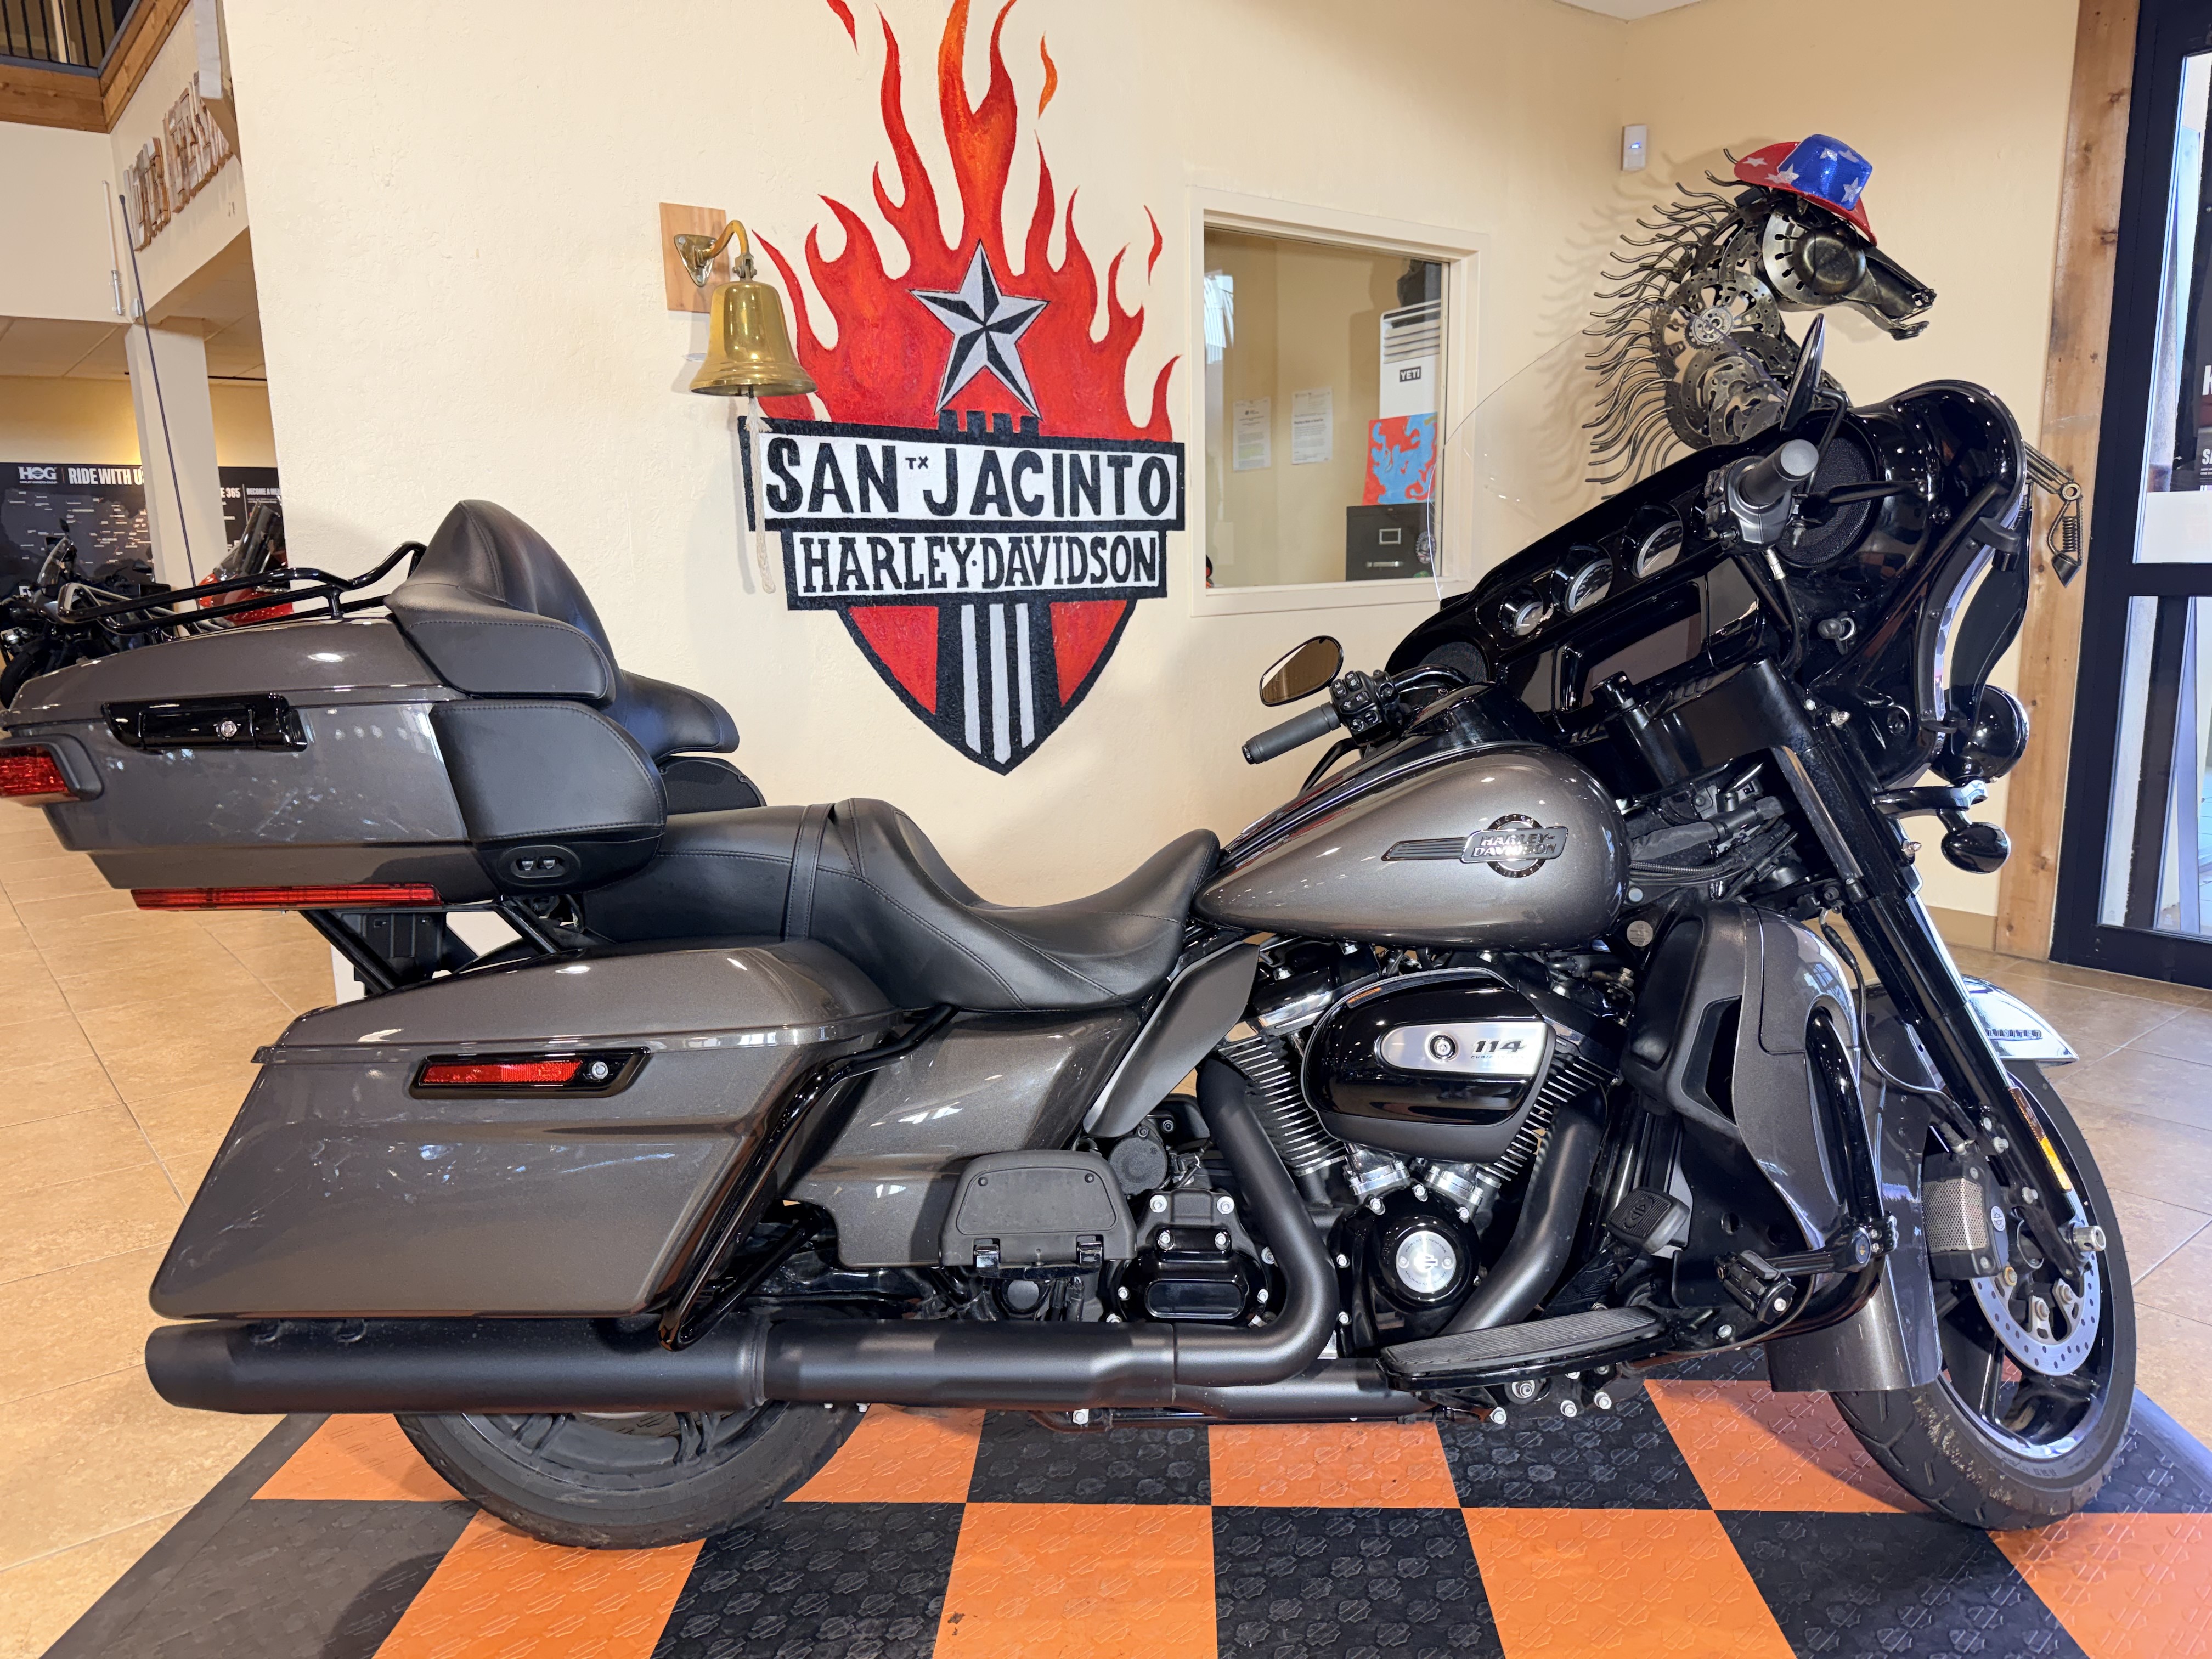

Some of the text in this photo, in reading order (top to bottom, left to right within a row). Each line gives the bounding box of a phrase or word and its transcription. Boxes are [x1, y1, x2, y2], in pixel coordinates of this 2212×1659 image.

[1400, 369, 1420, 380] YETI
[905, 456, 929, 470] TX
[18, 467, 57, 480] HOG
[68, 467, 144, 485] RIDE WITH U
[766, 437, 899, 513] SAN
[923, 448, 1171, 517] JACINTO
[225, 487, 241, 498] 365
[1471, 843, 1557, 857] DAVIDSON
[1989, 1029, 2042, 1037] LIMITED
[1473, 1039, 1526, 1053] 114
